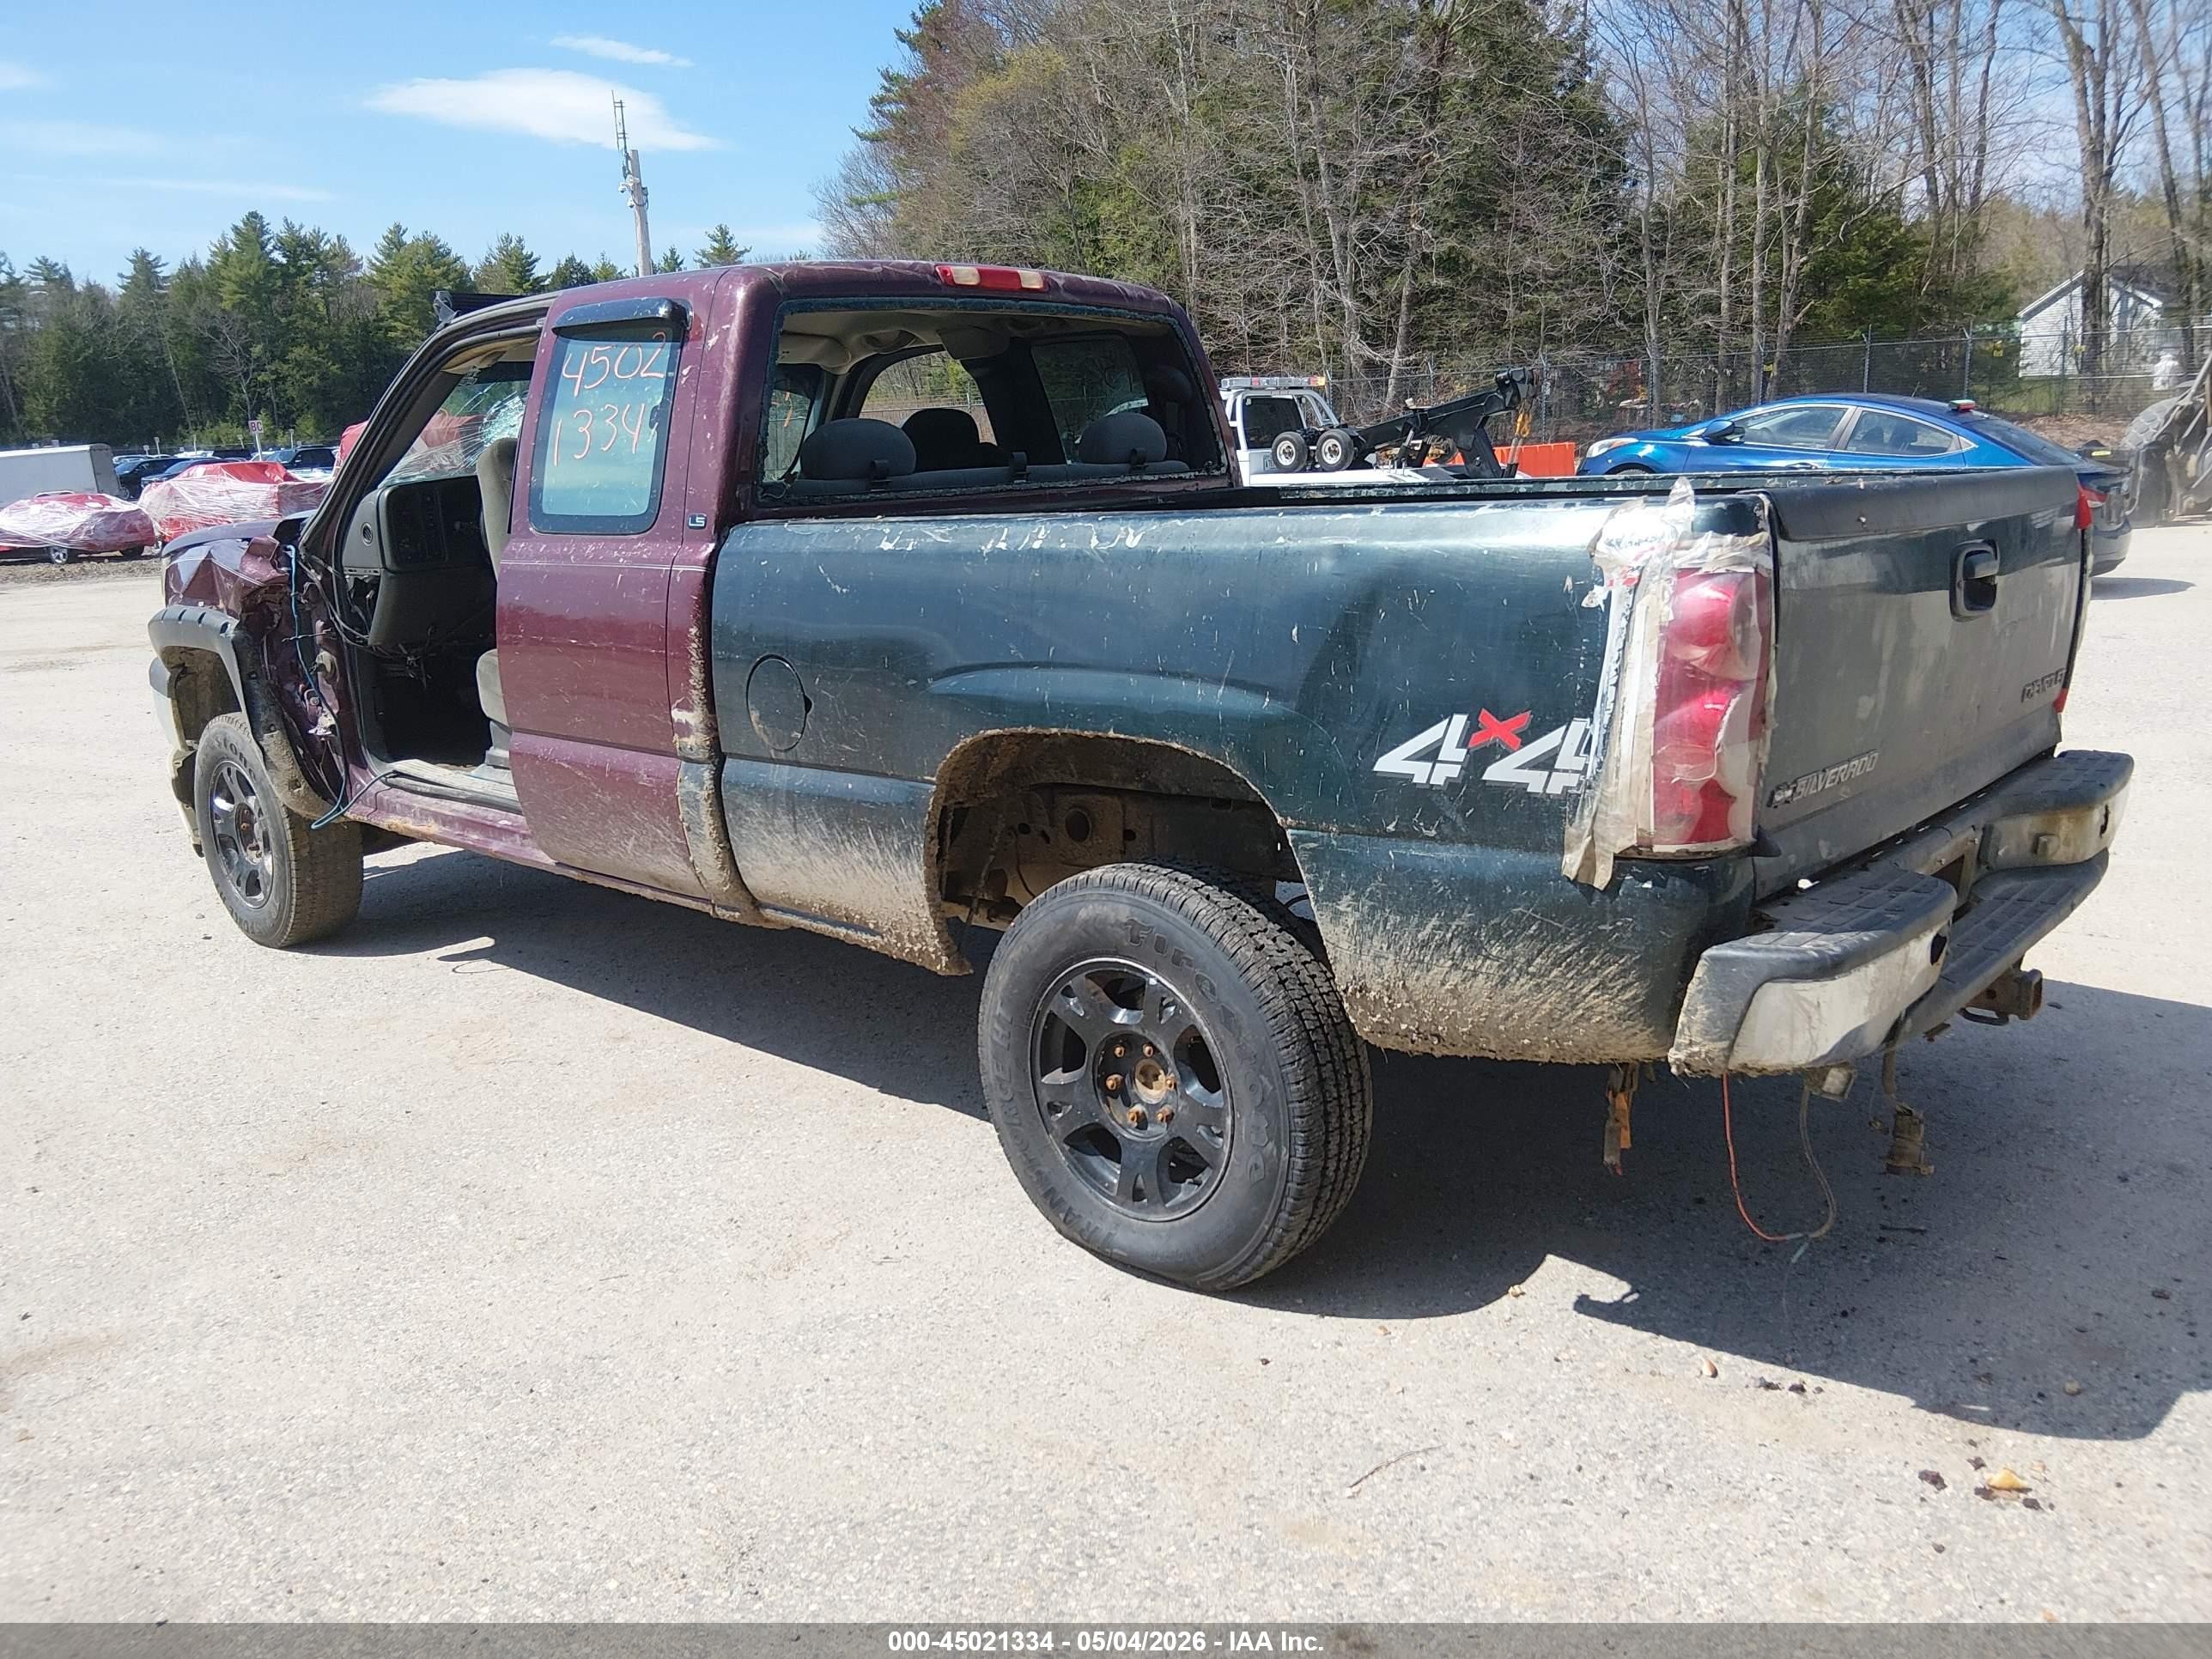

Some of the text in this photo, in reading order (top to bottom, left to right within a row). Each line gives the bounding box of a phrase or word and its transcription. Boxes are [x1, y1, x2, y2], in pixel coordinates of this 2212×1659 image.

[561, 331, 666, 398] 4502
[553, 403, 646, 467] 1334
[688, 515, 706, 527] LS
[1792, 750, 1879, 802] SILVERADO
